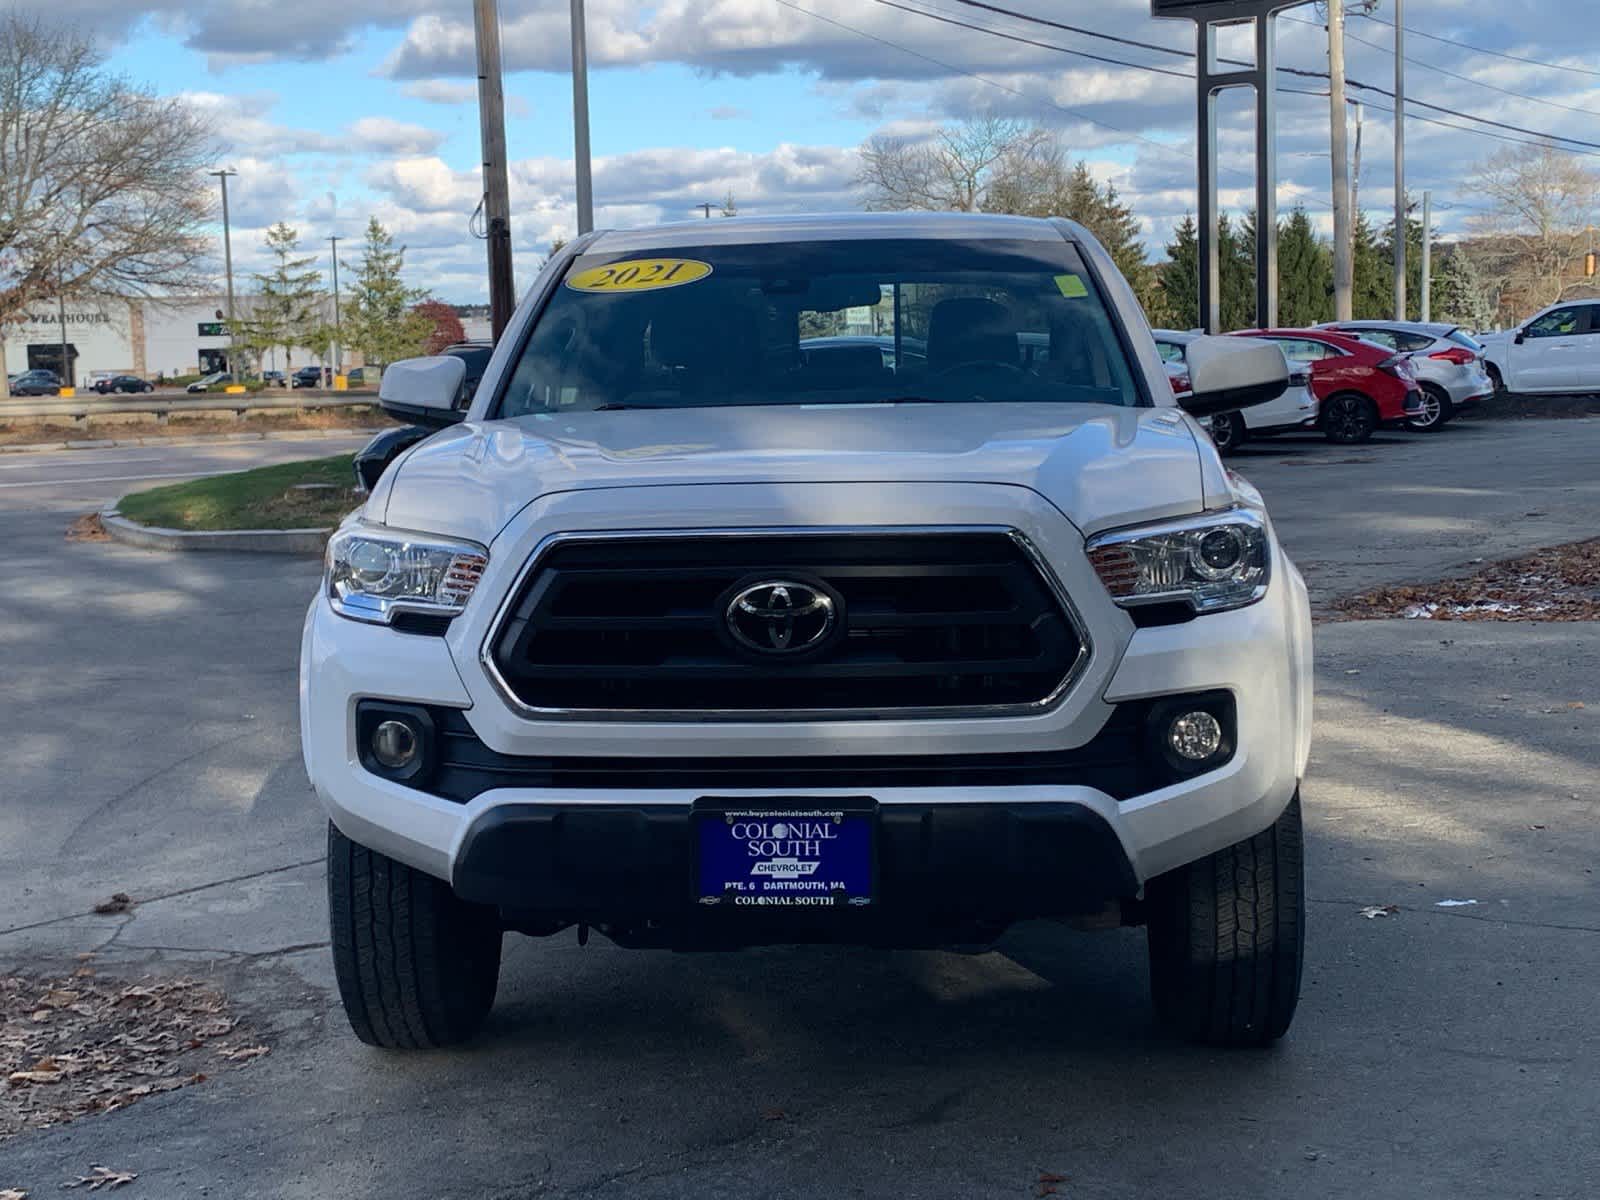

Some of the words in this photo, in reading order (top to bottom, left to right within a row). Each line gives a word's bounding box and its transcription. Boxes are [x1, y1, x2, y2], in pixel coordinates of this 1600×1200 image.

[588, 263, 685, 288] 2021
[724, 809, 844, 818] www.buycolonialsouth.com
[731, 823, 838, 839] COLONIAL
[748, 840, 821, 856] SOUTH
[757, 863, 813, 873] CHEVROLET
[748, 882, 756, 890] 6
[763, 882, 828, 891] DARTMOUTH,
[830, 881, 846, 890] MA
[735, 896, 794, 905] COLONIAL
[795, 896, 835, 905] SOUTH
